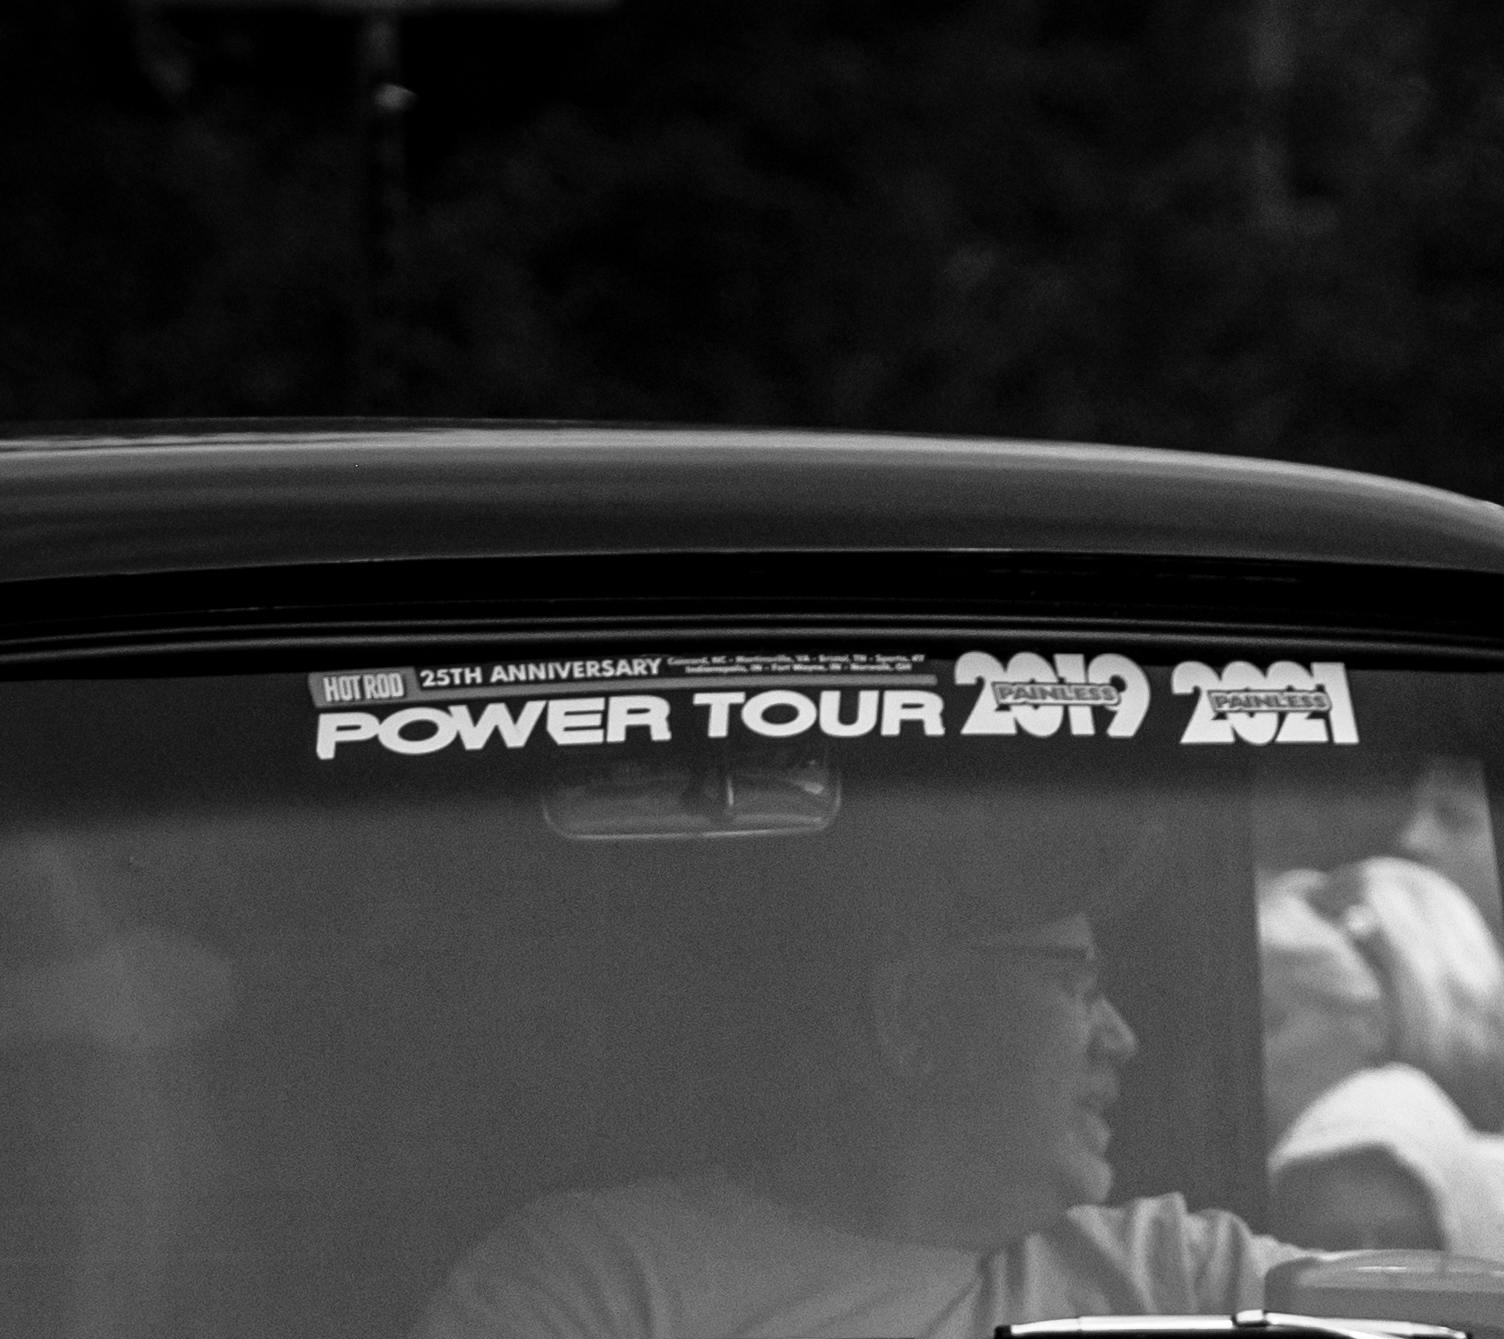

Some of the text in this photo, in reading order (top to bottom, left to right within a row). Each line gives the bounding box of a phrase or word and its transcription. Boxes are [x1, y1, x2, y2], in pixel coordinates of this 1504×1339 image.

[322, 671, 405, 702] HOT ROD
[420, 657, 662, 688] 25TH ANNIVERSARY
[954, 651, 1151, 738] 2019
[998, 685, 1116, 702] PAINLESS
[1171, 660, 1360, 746] 2021
[1213, 693, 1328, 709] PAINLESS
[315, 689, 946, 760] POWER TOUR
